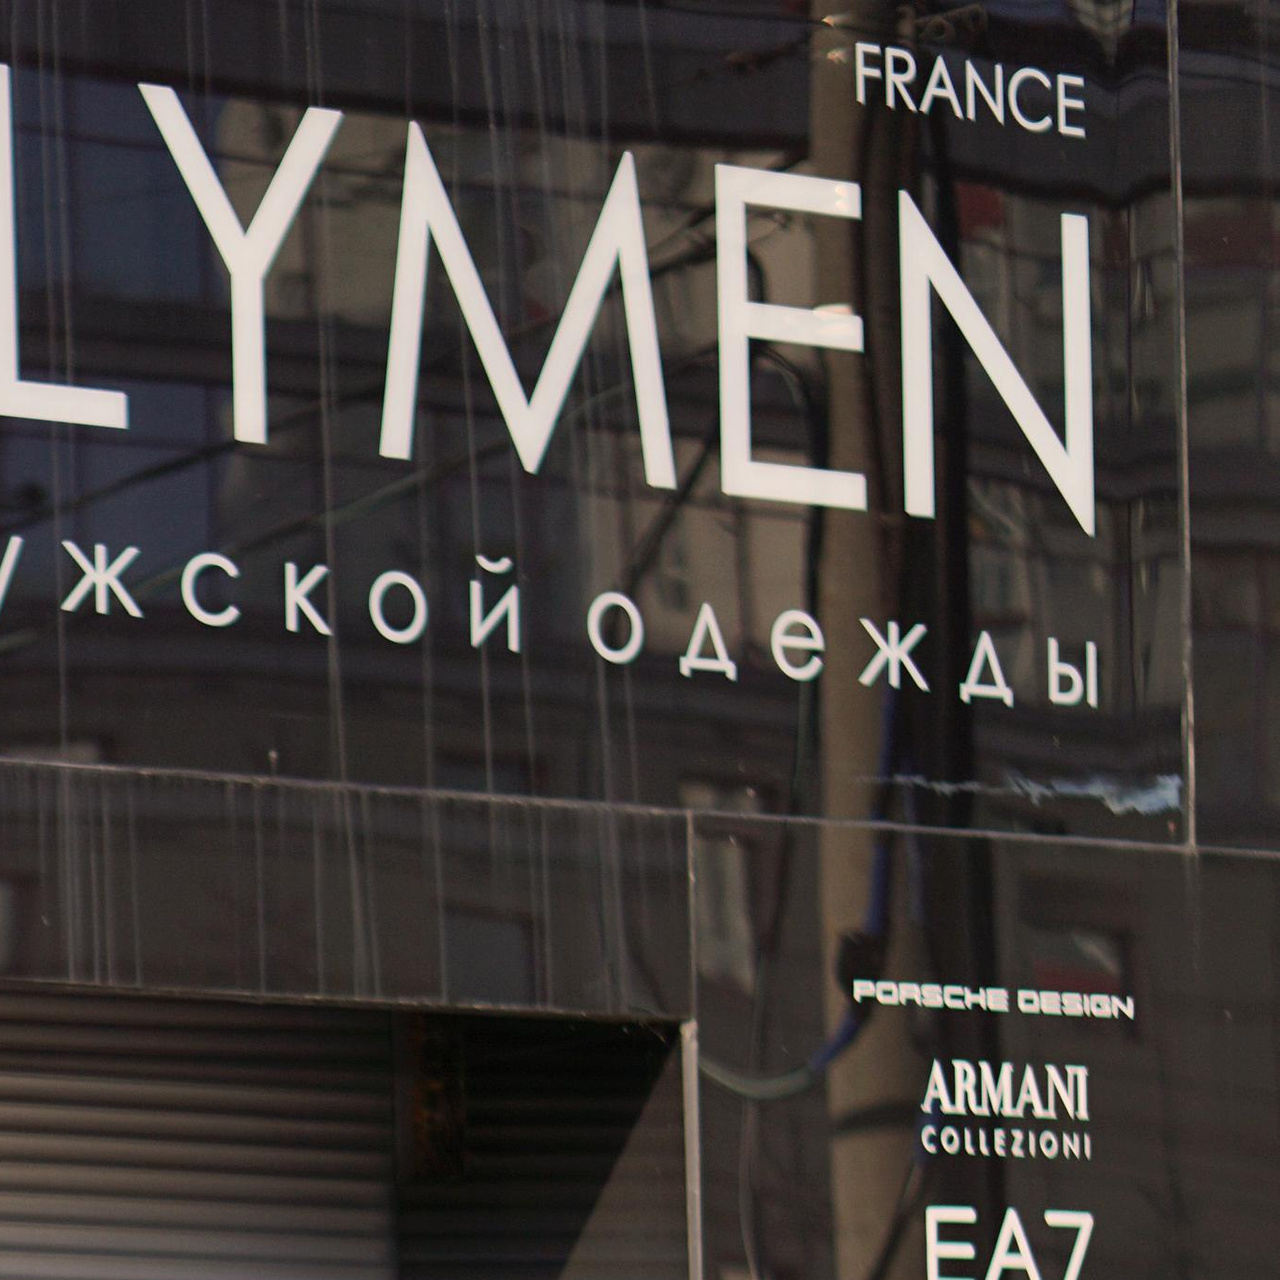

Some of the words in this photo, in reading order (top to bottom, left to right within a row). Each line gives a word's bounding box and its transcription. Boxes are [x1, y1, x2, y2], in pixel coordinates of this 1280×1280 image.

[855, 42, 1086, 138] FRANCE
[587, 592, 1099, 708] одежды
[853, 978, 1010, 1013] PORSCHE
[1017, 988, 1135, 1020] DESIGN
[920, 1058, 1090, 1121] ARMANI
[921, 1124, 1092, 1160] COLLEZIONI
